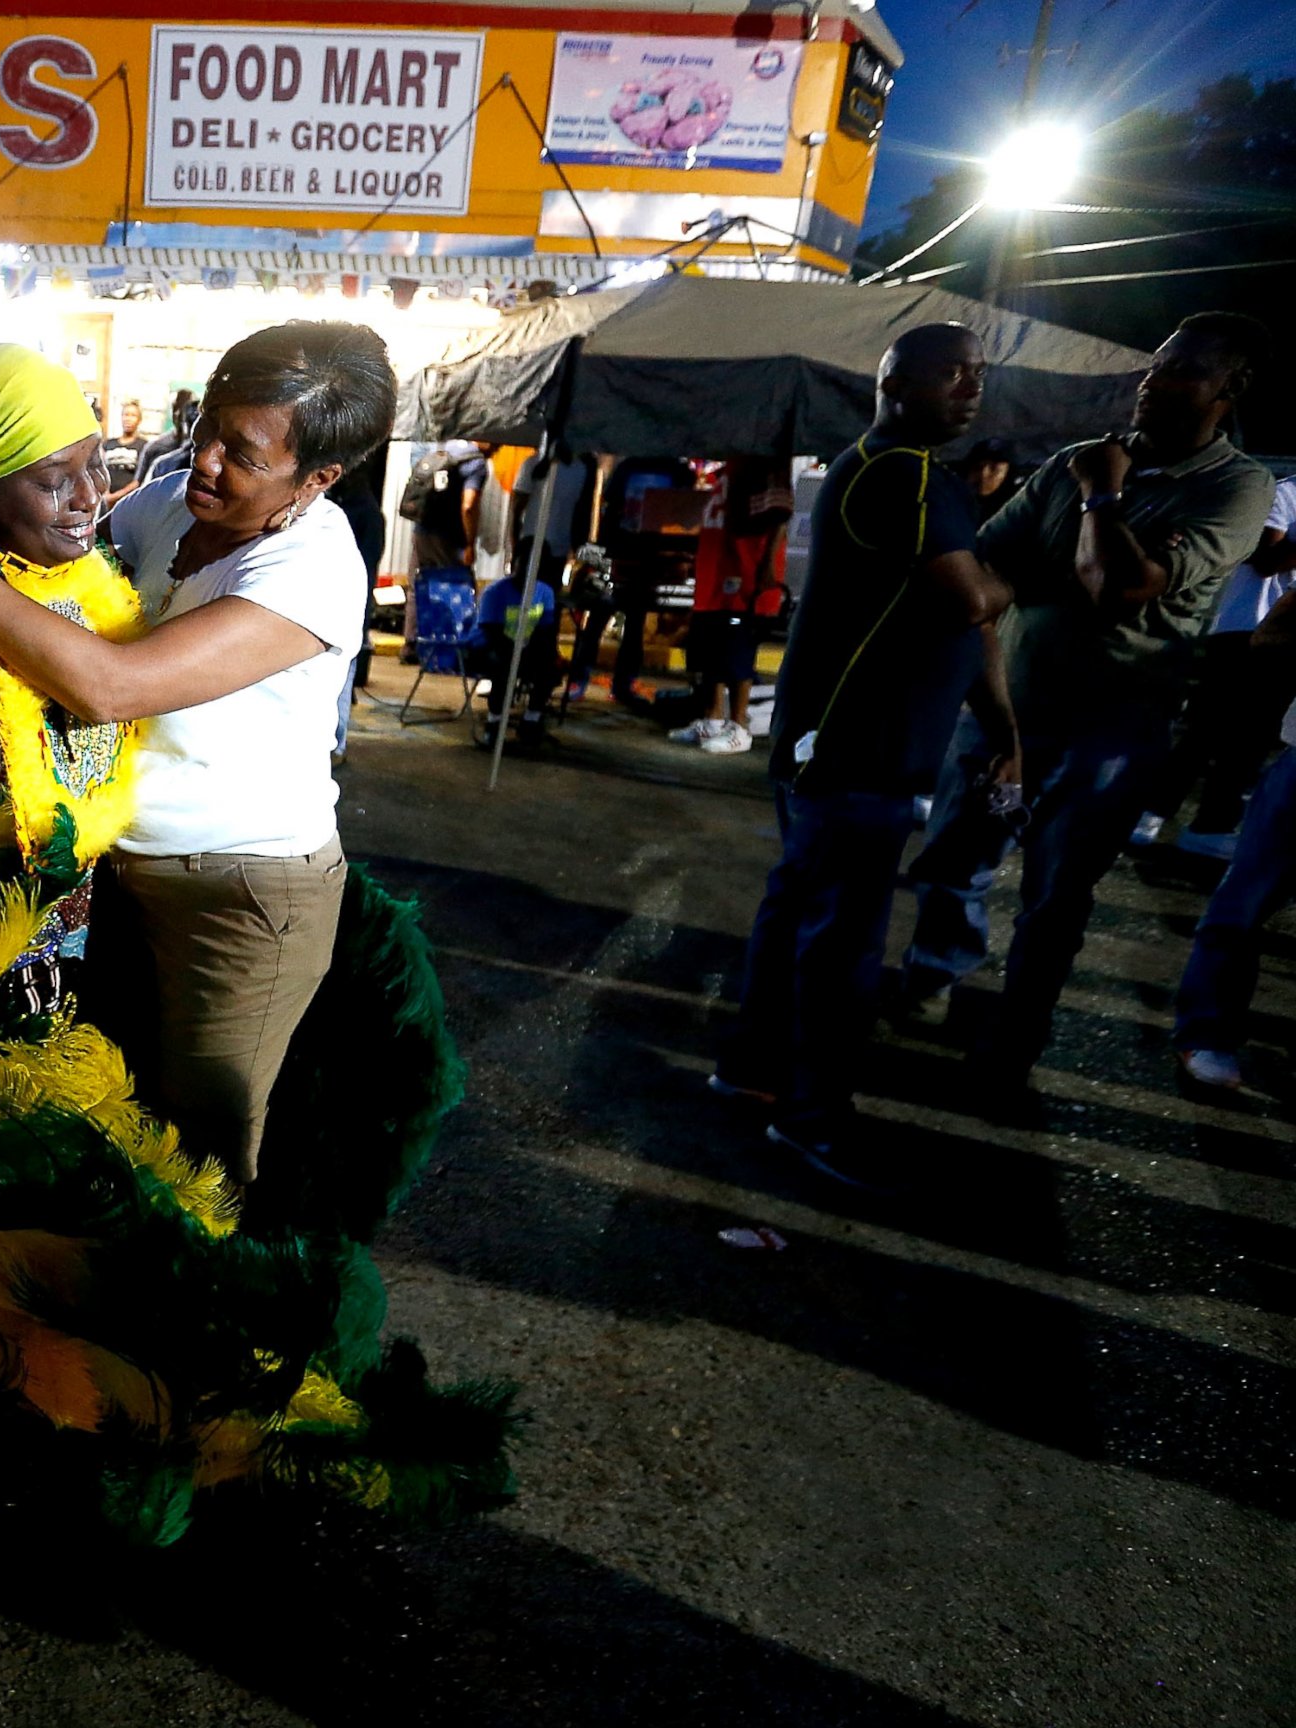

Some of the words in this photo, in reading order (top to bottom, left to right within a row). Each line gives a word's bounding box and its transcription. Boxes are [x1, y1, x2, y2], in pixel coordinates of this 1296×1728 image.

[170, 43, 303, 102] FOOD
[321, 46, 461, 108] MART
[172, 118, 258, 149] DELI
[291, 120, 450, 153] GROCERY
[307, 168, 320, 195] &
[334, 169, 443, 197] LIQUOR
